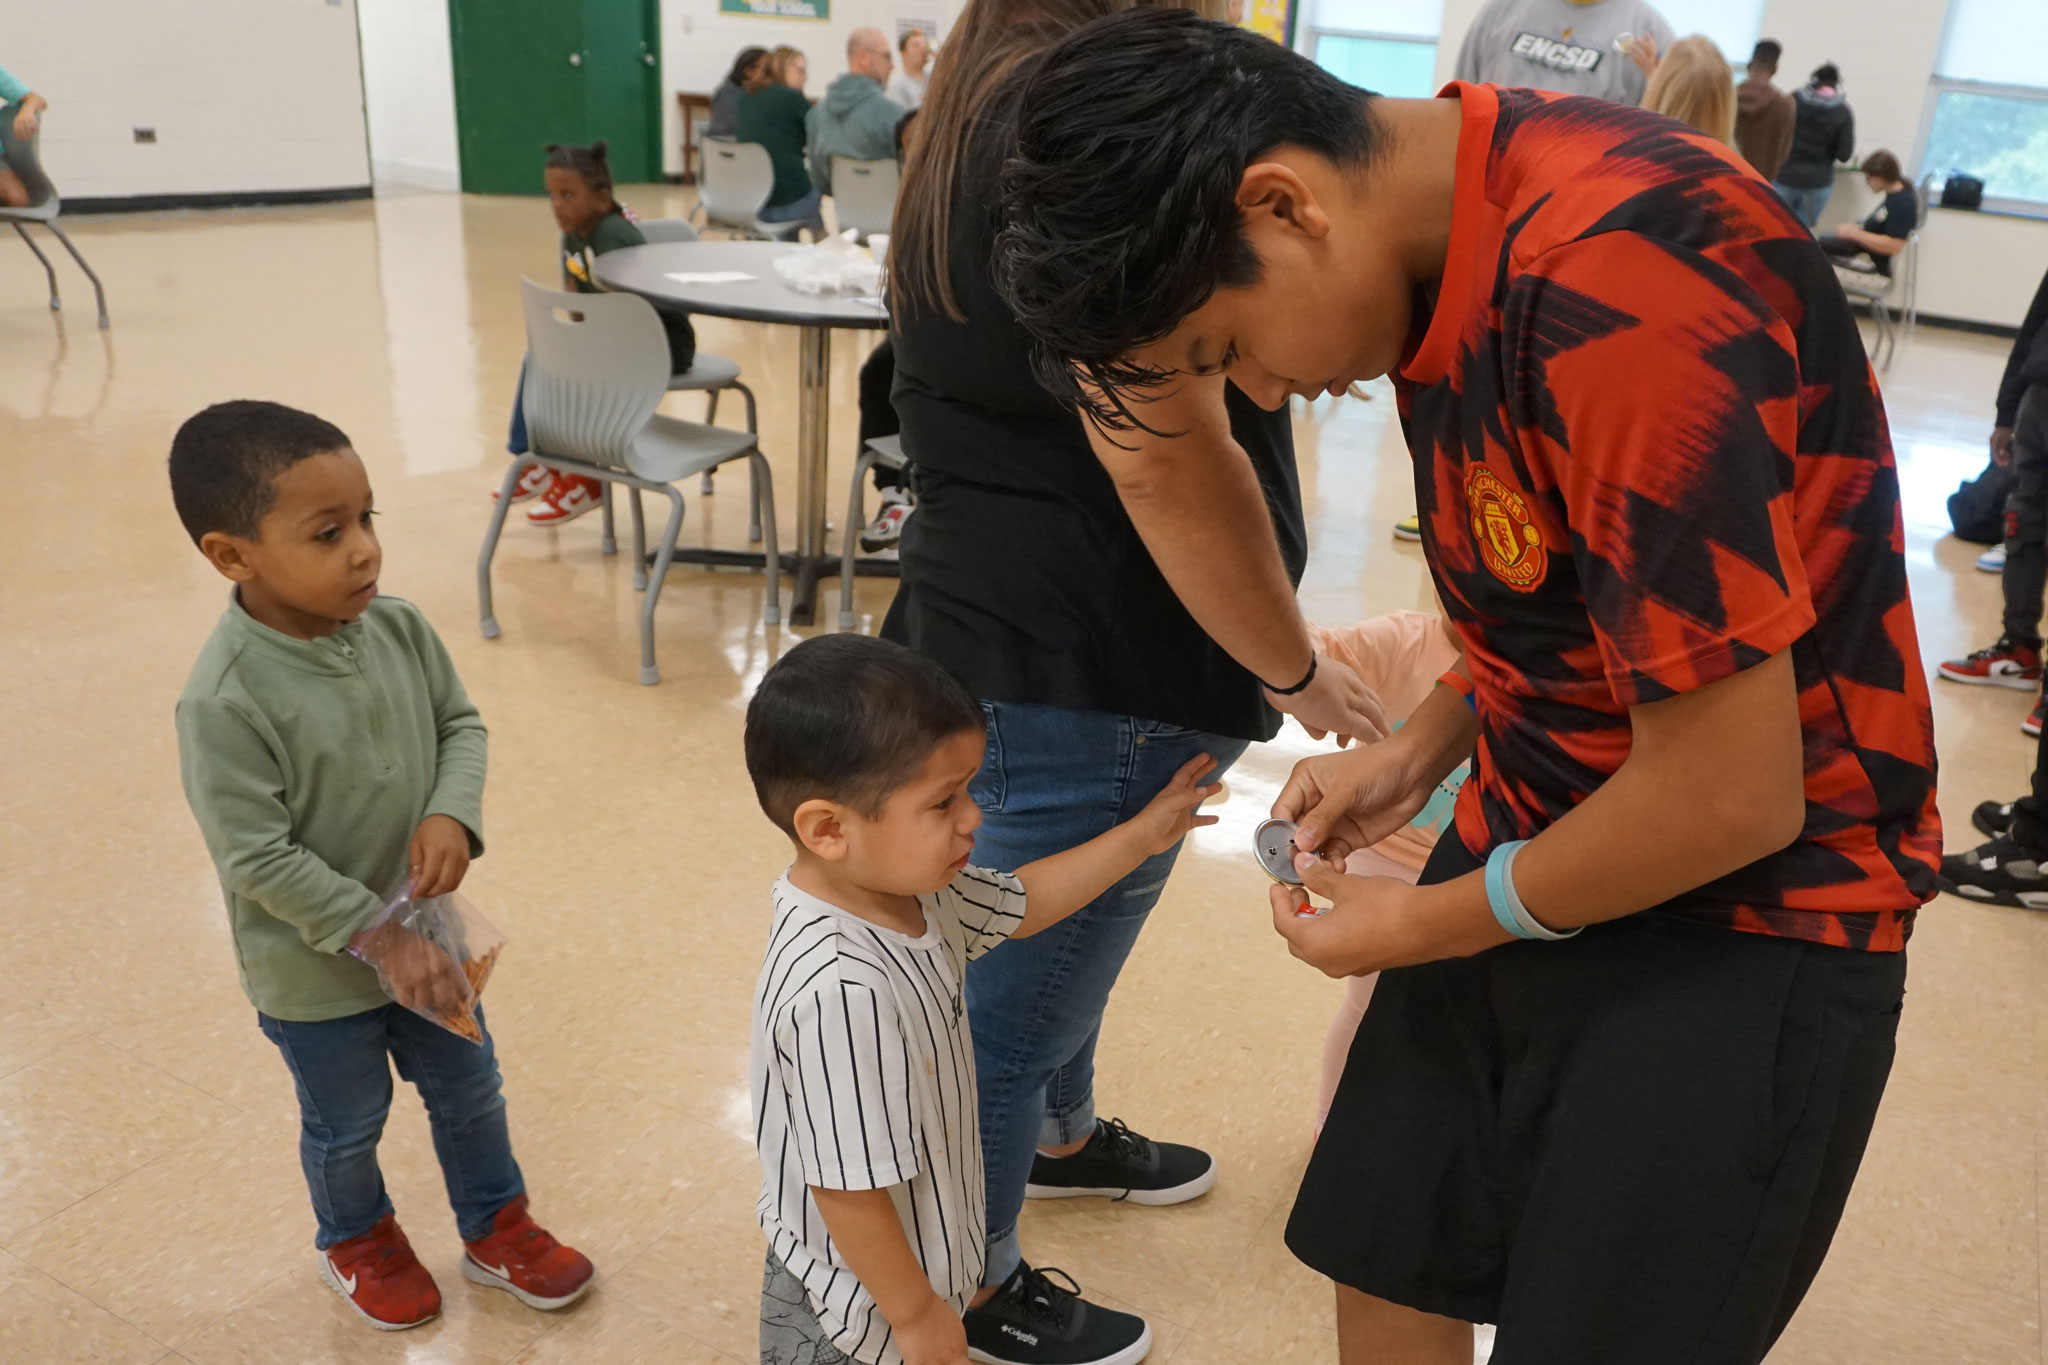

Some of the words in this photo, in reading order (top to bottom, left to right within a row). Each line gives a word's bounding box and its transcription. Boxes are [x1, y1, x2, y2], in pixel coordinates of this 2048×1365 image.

[1512, 33, 1599, 70] ENCSD
[1473, 478, 1521, 516] MANCHESTER
[1494, 558, 1534, 578] UNITED
